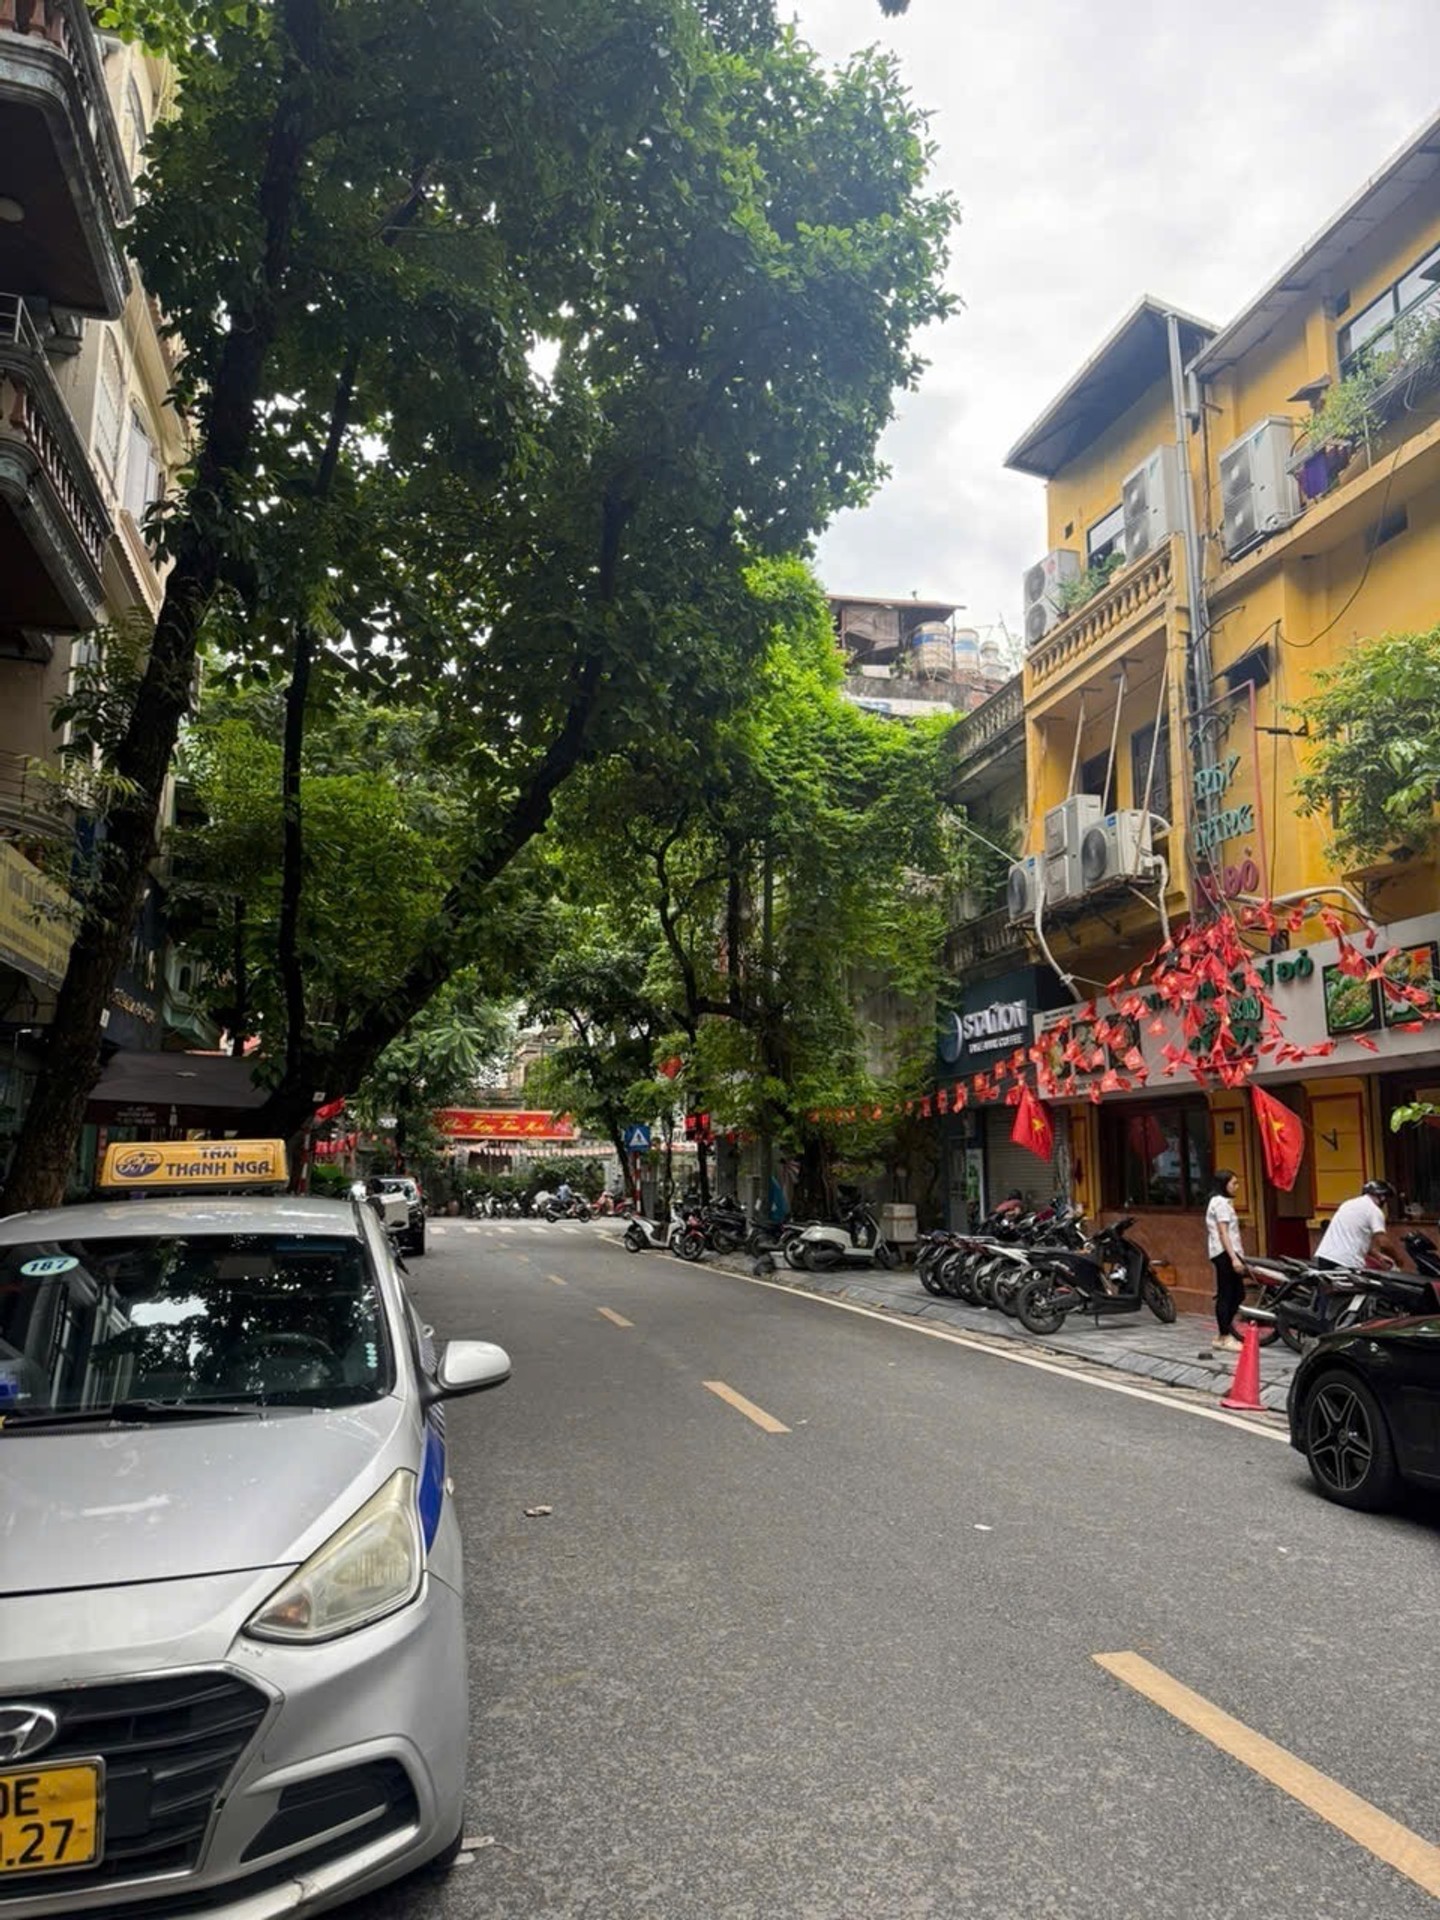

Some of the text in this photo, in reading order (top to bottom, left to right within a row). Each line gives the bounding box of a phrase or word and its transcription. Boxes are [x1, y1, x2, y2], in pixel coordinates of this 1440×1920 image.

[166, 1161, 226, 1177] THANH
[233, 1160, 270, 1174] NGA
[31, 1260, 68, 1272] 187
[0, 1818, 74, 1866] .27
